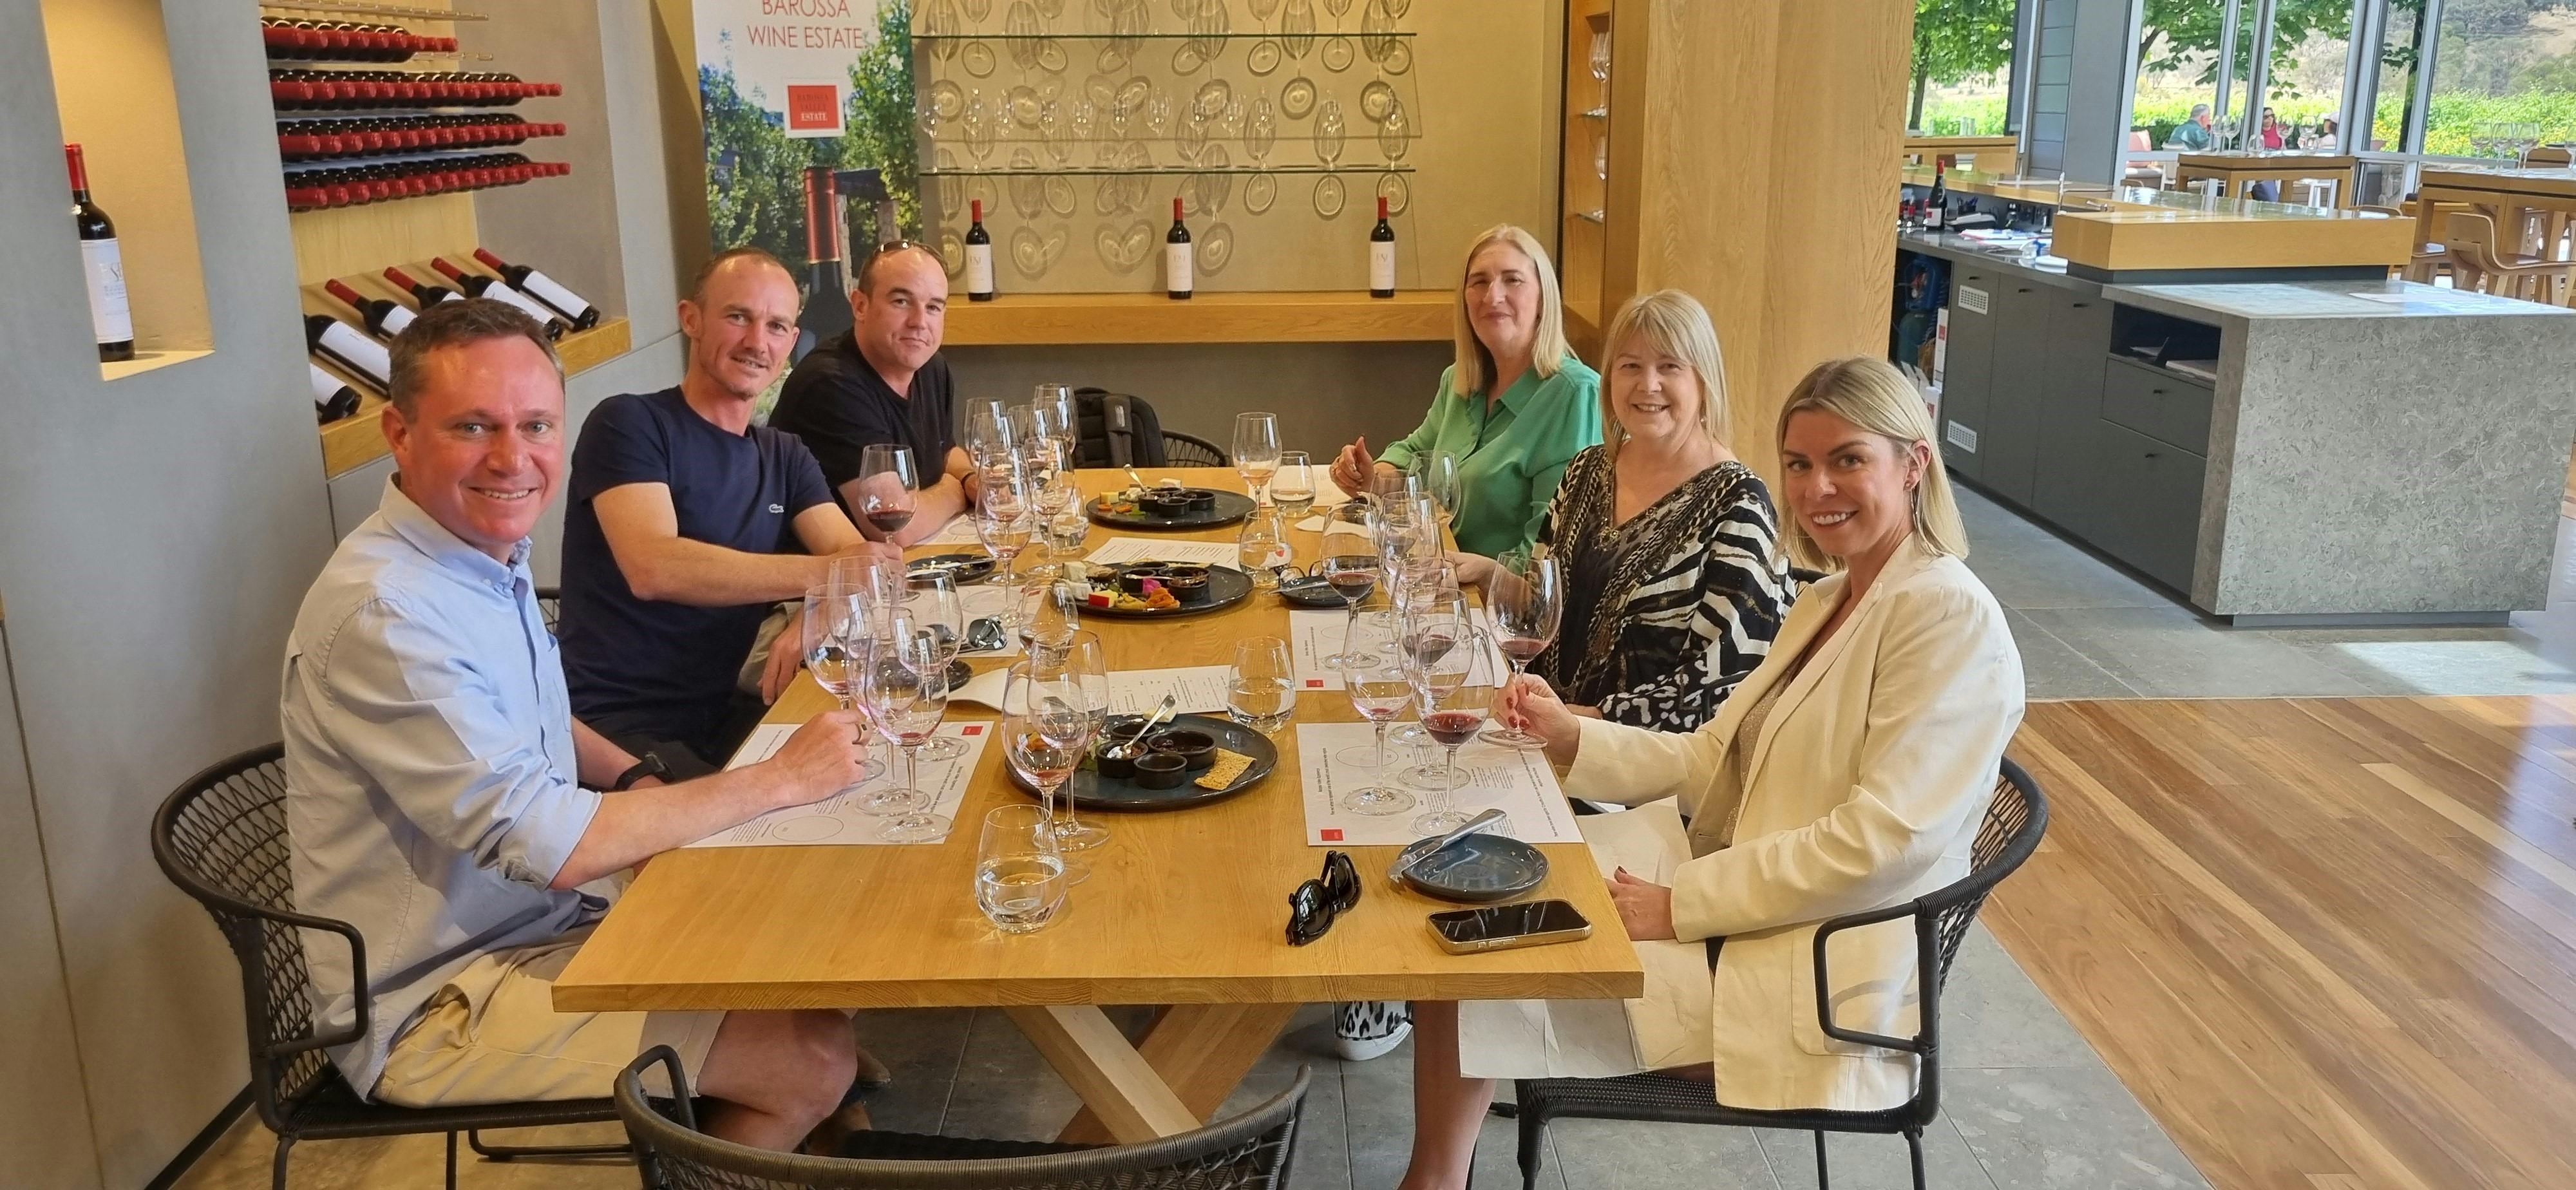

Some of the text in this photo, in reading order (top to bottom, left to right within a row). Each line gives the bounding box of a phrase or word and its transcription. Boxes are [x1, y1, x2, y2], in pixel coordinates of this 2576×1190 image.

[763, 0, 850, 17] BAROSSA
[747, 25, 799, 48] WINE
[800, 113, 828, 121] ESTATE
